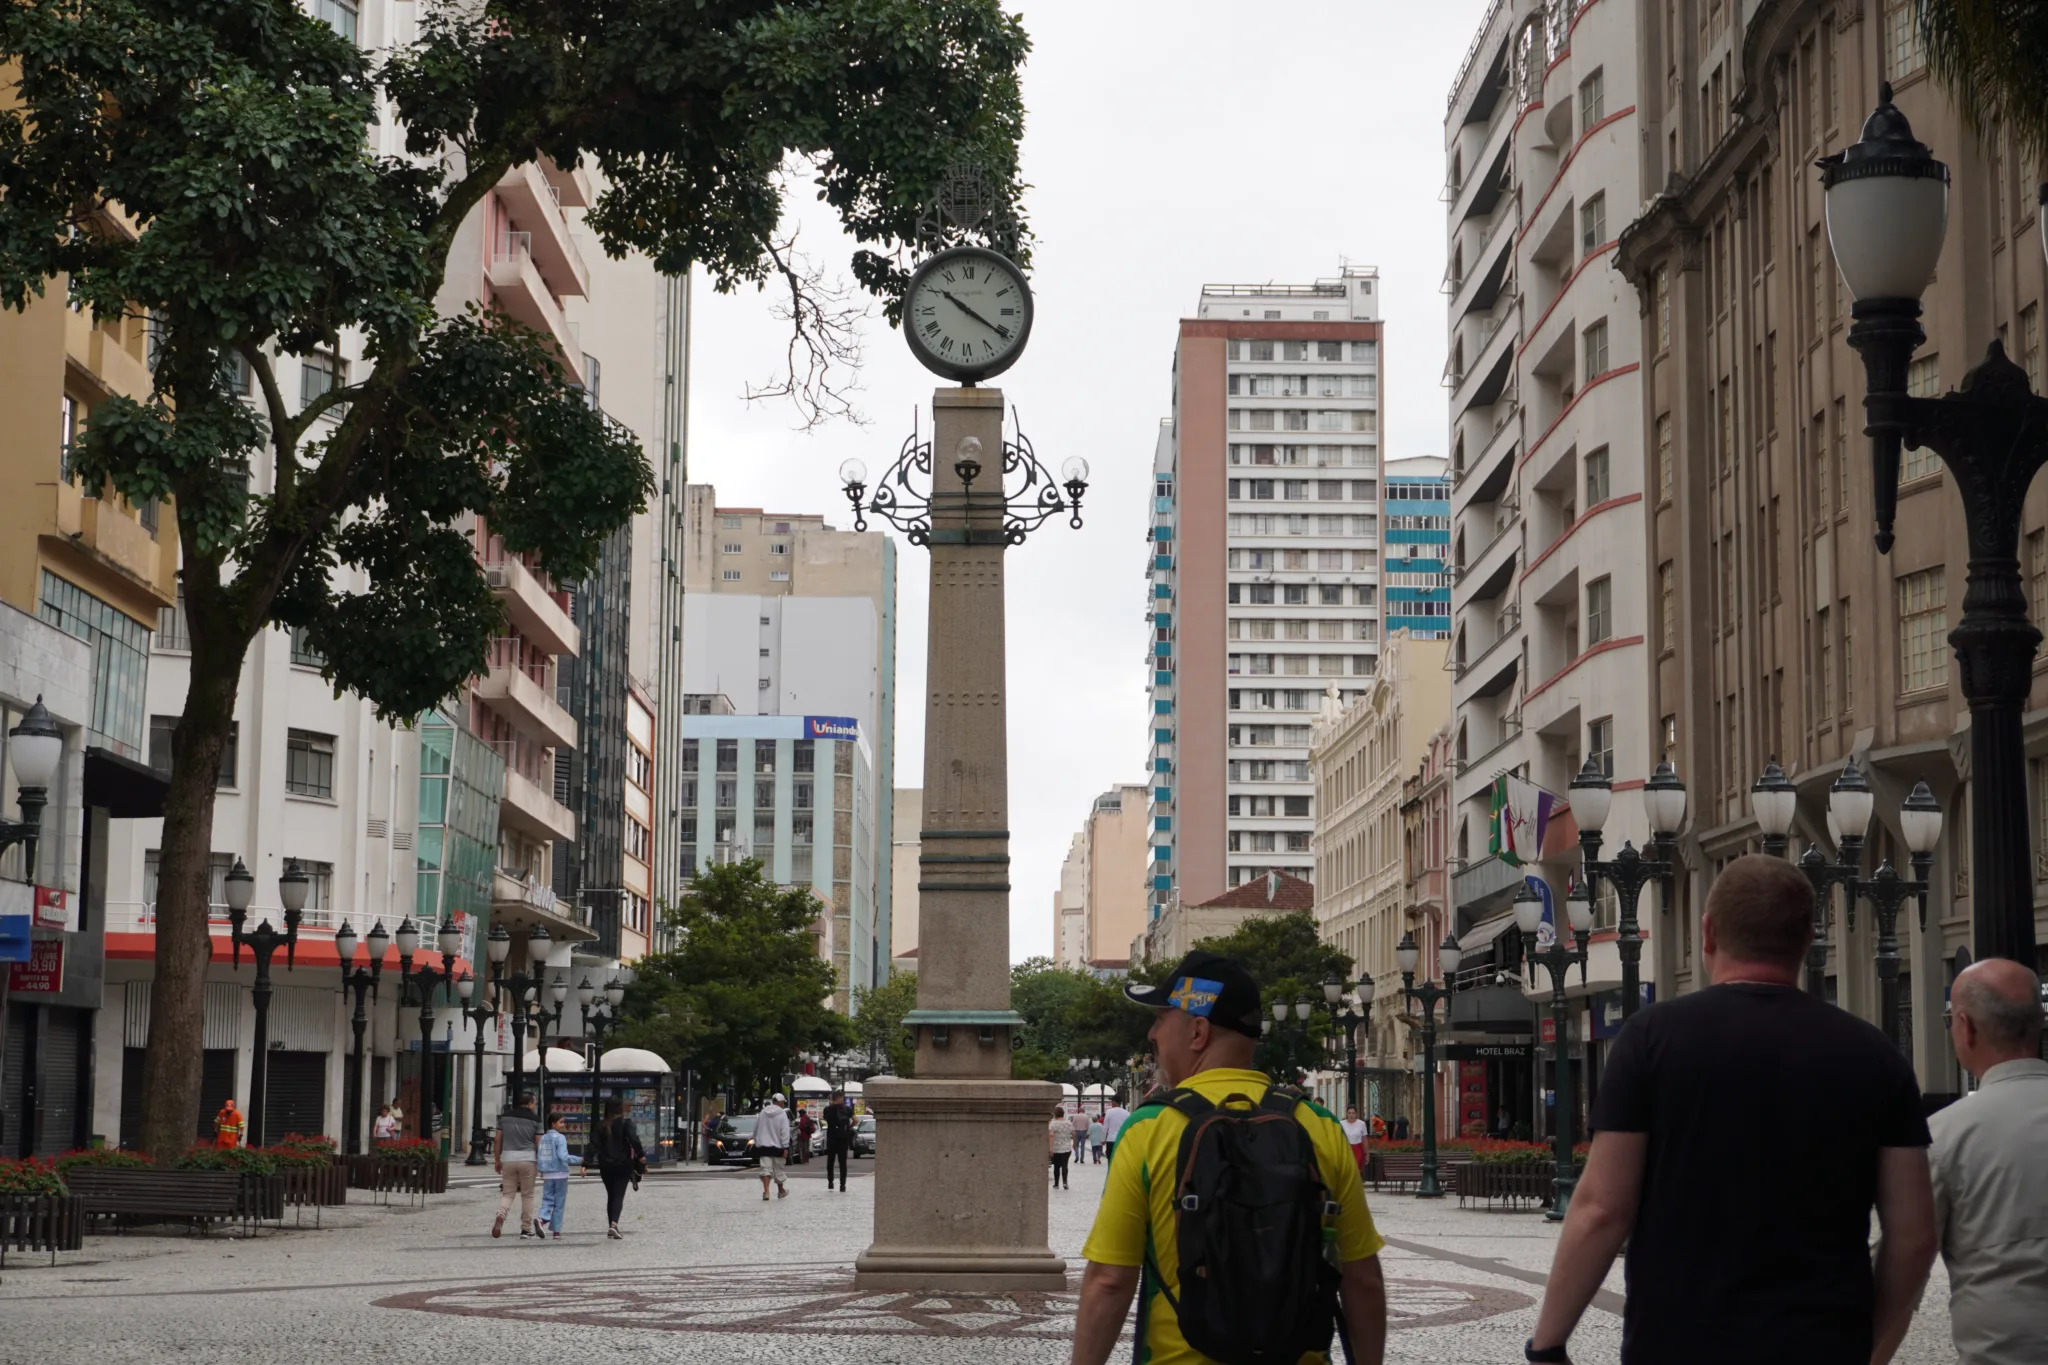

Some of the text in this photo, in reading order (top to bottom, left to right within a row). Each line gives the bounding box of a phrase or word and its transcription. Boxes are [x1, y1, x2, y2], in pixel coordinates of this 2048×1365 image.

[941, 270, 956, 285] XI
[962, 266, 974, 280] XII
[1476, 1047, 1526, 1056] HOTEL BRAZ
